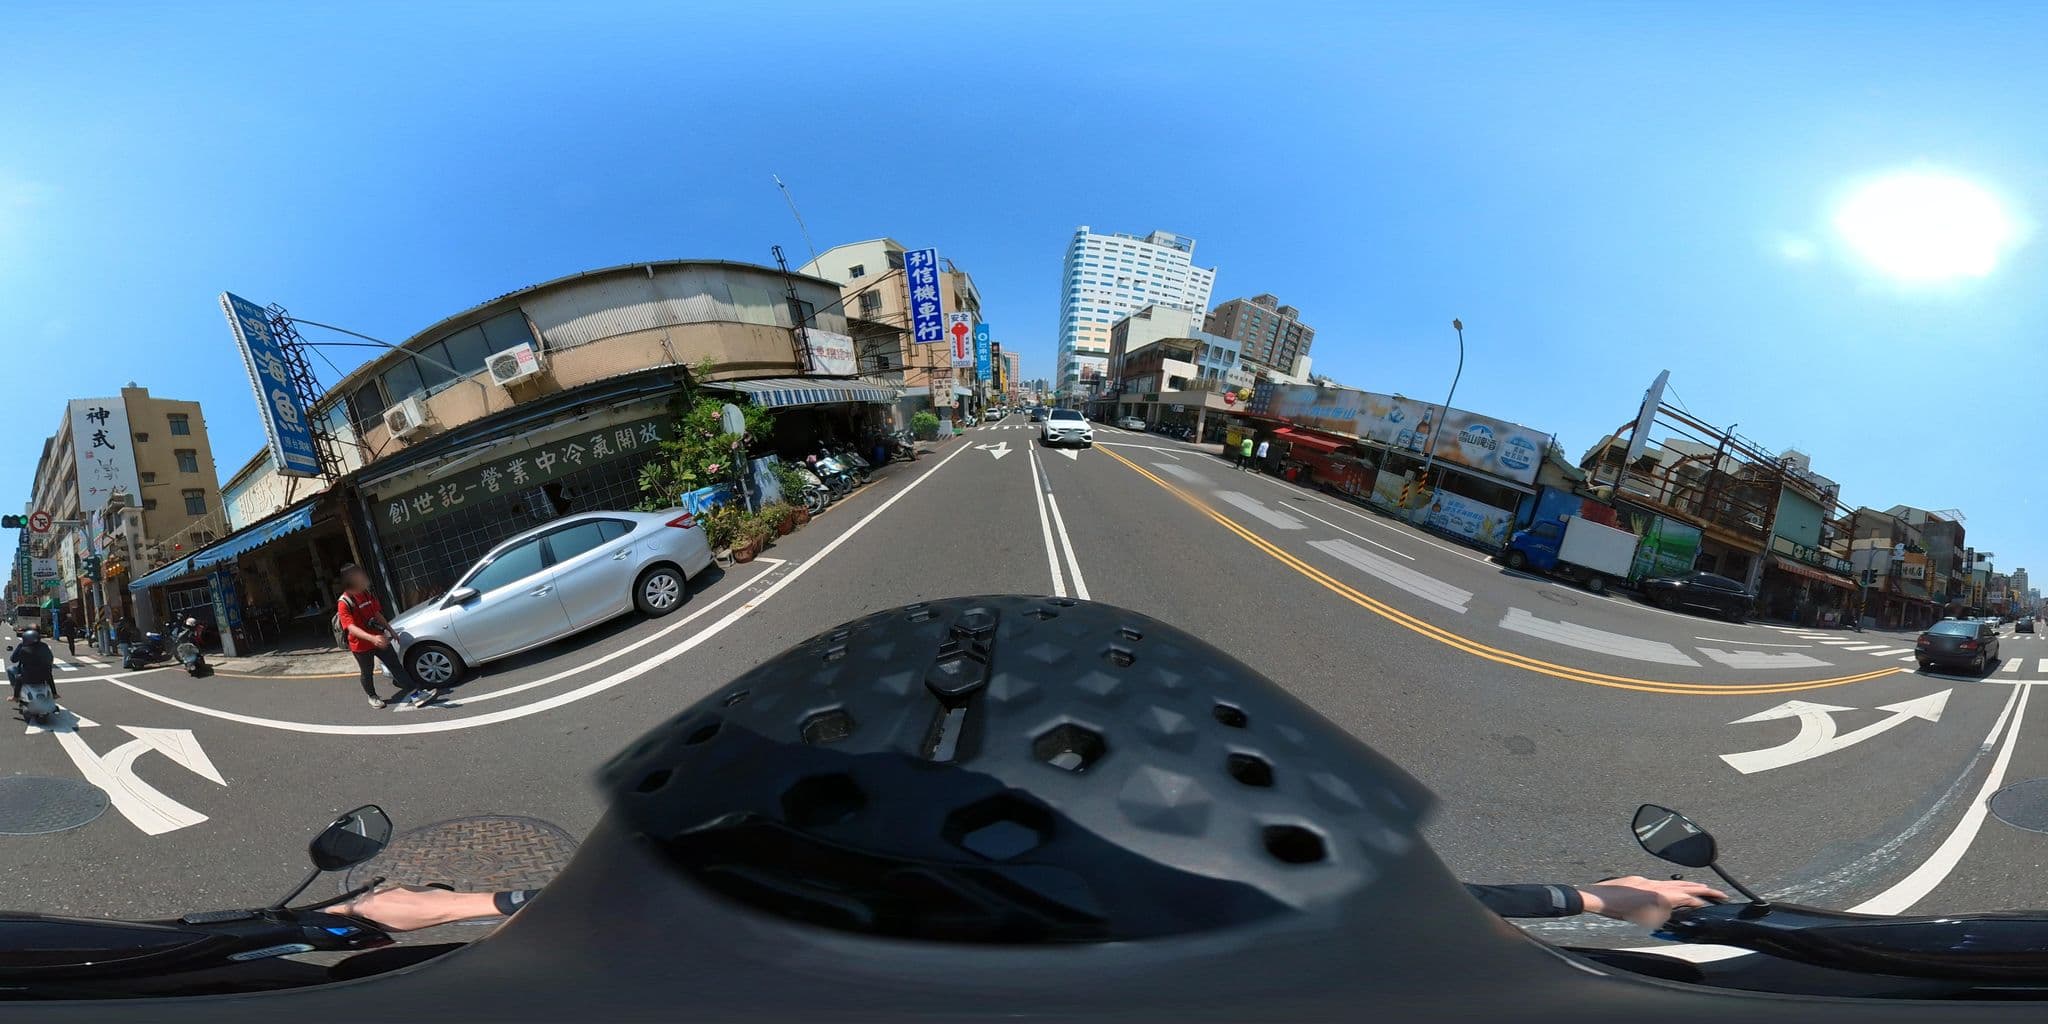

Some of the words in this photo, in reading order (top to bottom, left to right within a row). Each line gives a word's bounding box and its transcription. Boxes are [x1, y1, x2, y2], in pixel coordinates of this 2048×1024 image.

[910, 250, 940, 340] 利信機車行
[951, 313, 969, 321] 安全
[239, 314, 305, 433] 深海魚
[86, 407, 115, 450] 神武
[1457, 430, 1497, 451] 雪山啤酒
